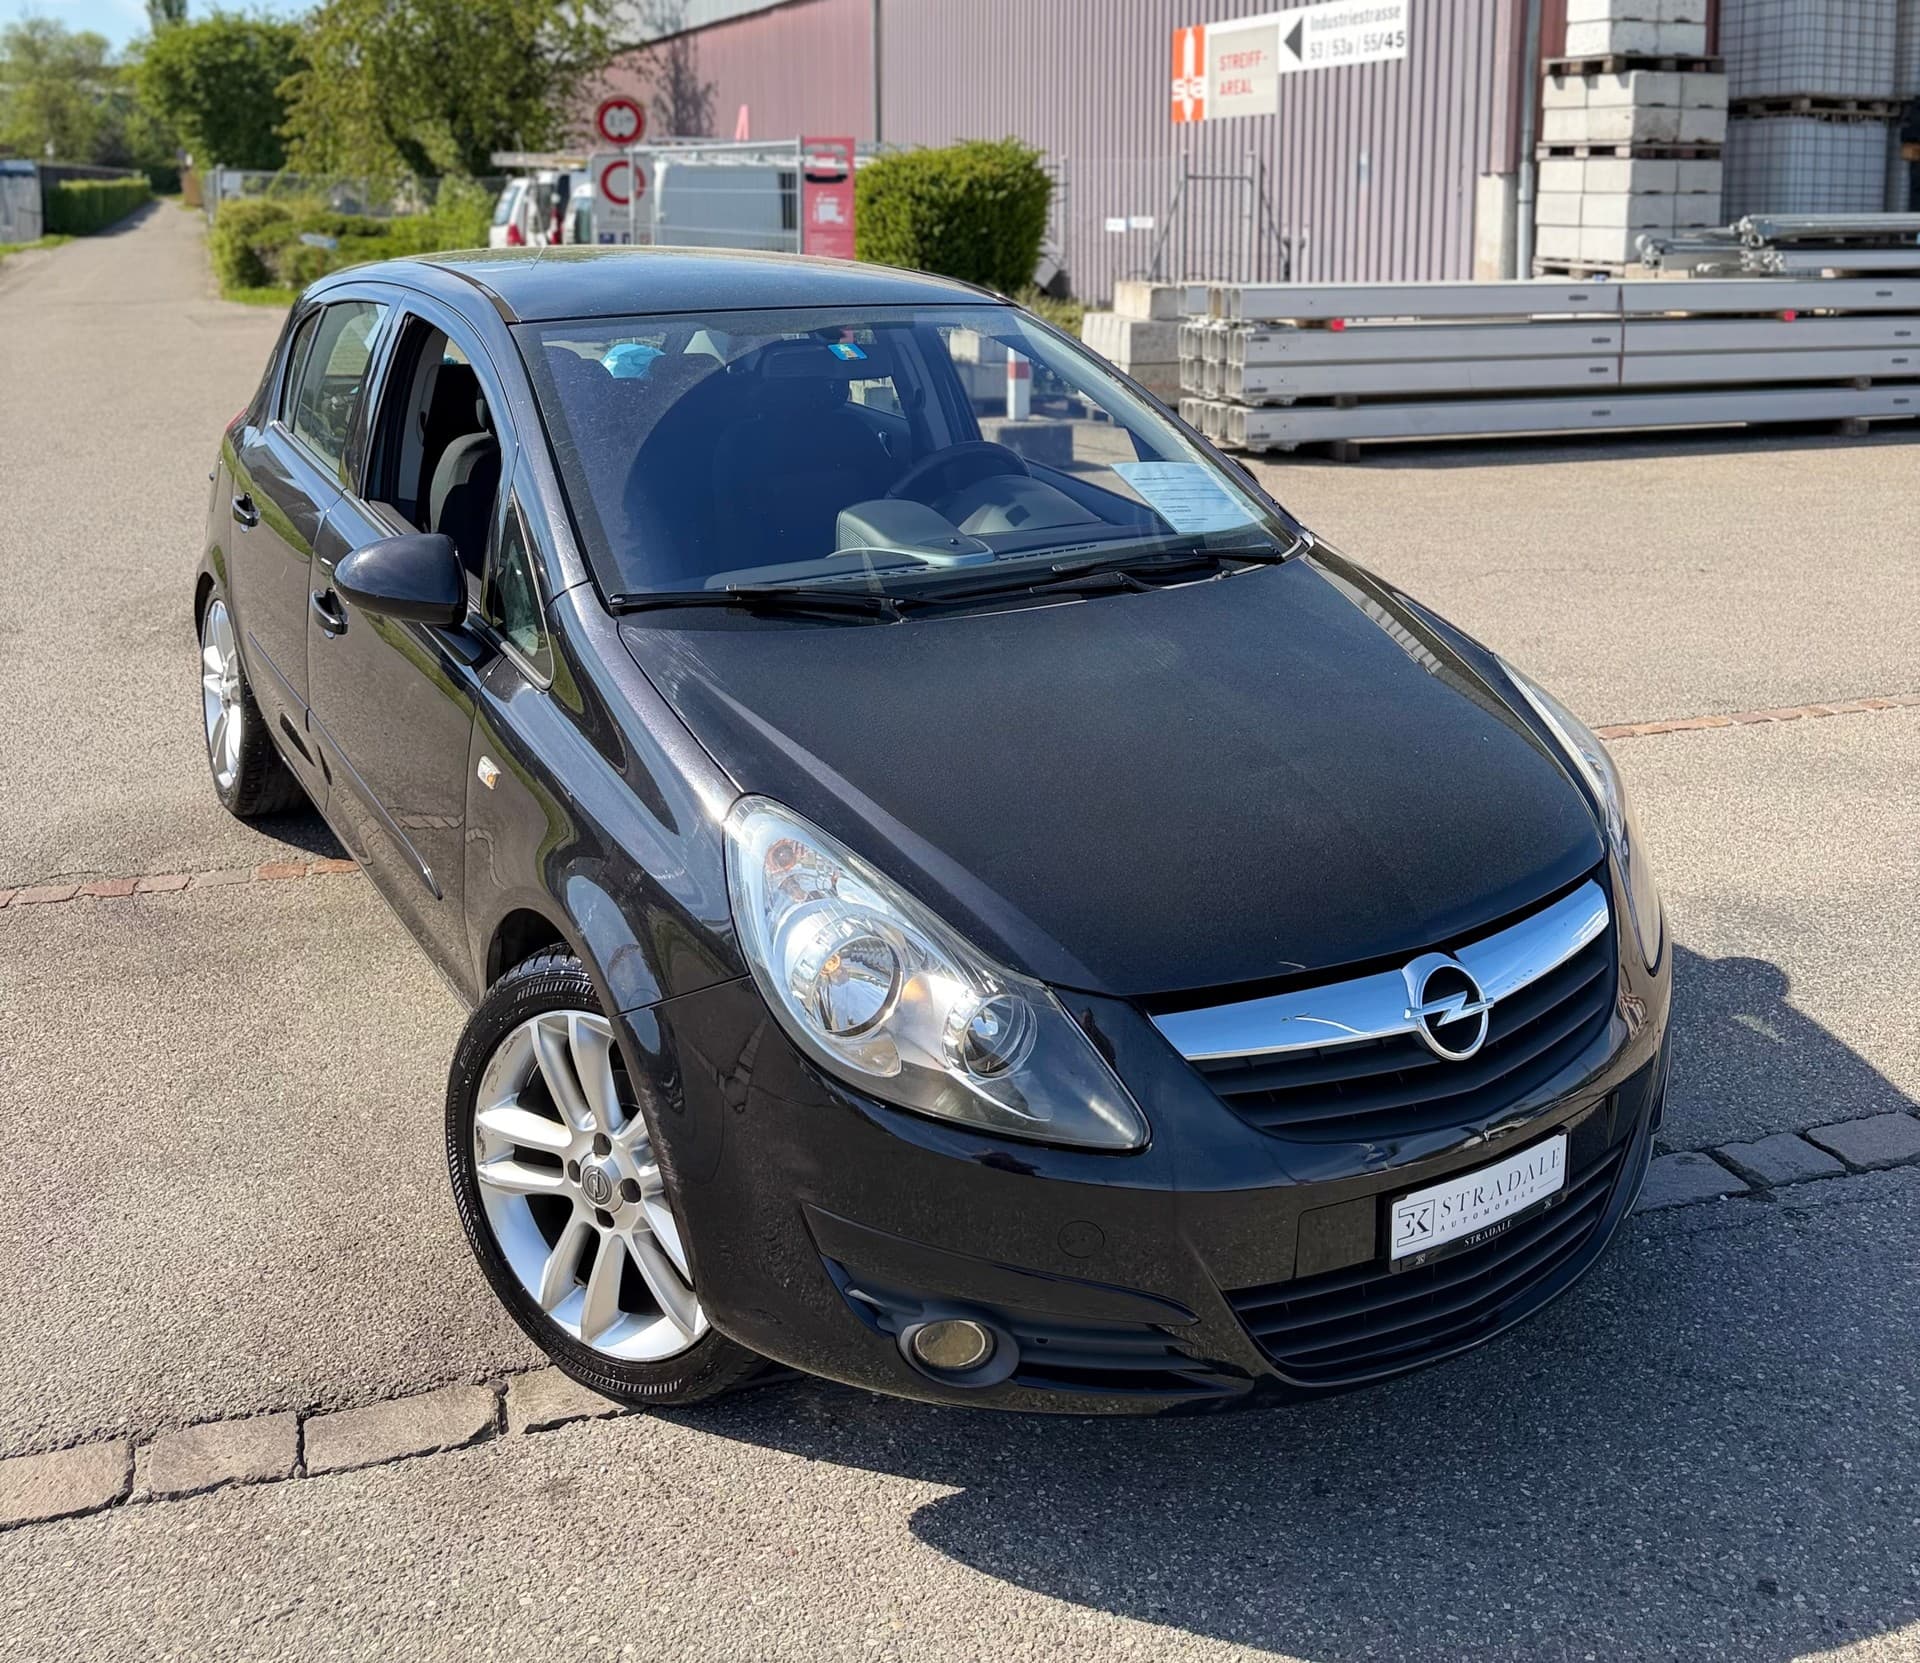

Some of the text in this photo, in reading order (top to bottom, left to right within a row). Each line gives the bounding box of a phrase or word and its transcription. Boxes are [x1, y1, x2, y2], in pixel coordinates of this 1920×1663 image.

[1310, 6, 1401, 31] Industriestrasse
[1219, 78, 1254, 96] AREAL
[1440, 1147, 1560, 1218] STRADALE
[1440, 1186, 1535, 1232] AUTOMOBILE
[1464, 1219, 1513, 1247] STRADALE
